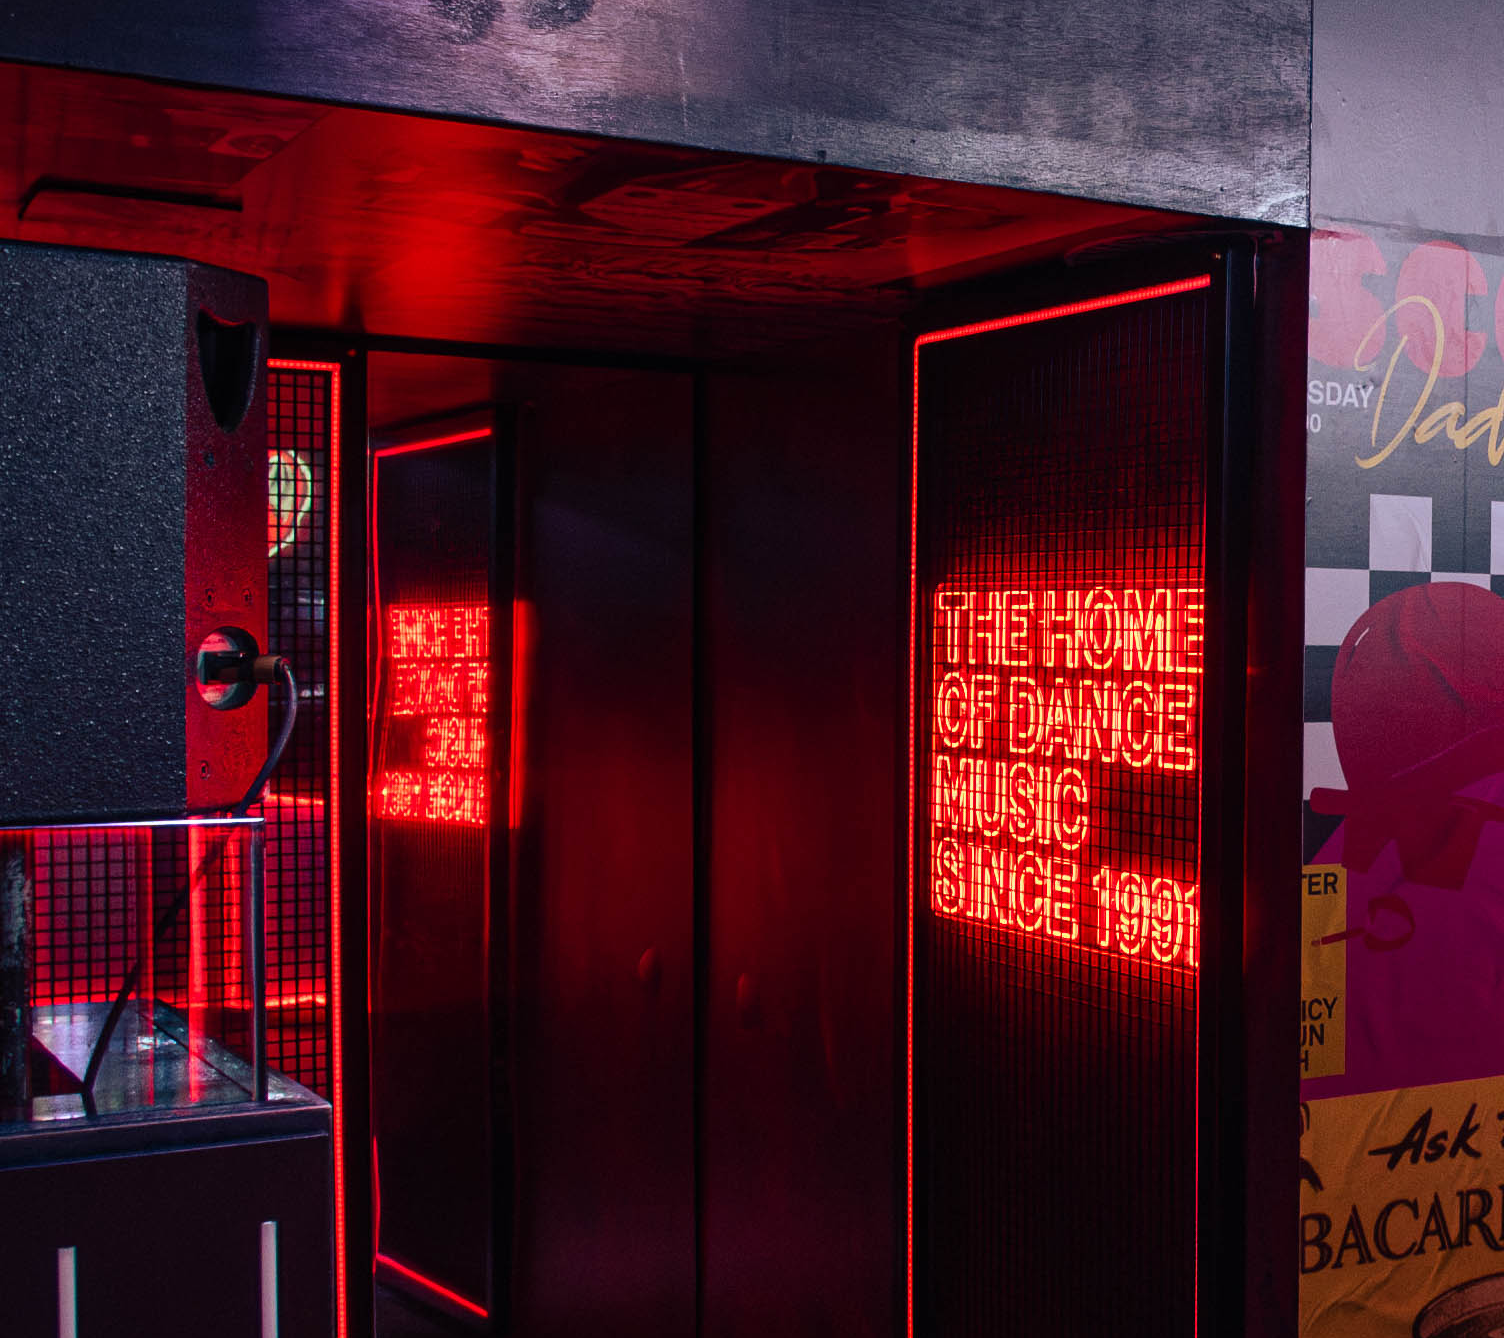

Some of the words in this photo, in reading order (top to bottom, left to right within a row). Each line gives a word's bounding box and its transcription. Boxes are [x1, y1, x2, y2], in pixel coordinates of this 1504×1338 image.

[937, 589, 1034, 668] THE
[1045, 585, 1205, 675] HOME
[936, 671, 1000, 749] OF
[1008, 676, 1196, 772] DANCE
[934, 754, 1089, 852] MUSIC
[935, 836, 1079, 941] SINCE
[1368, 1103, 1483, 1171] Ask
